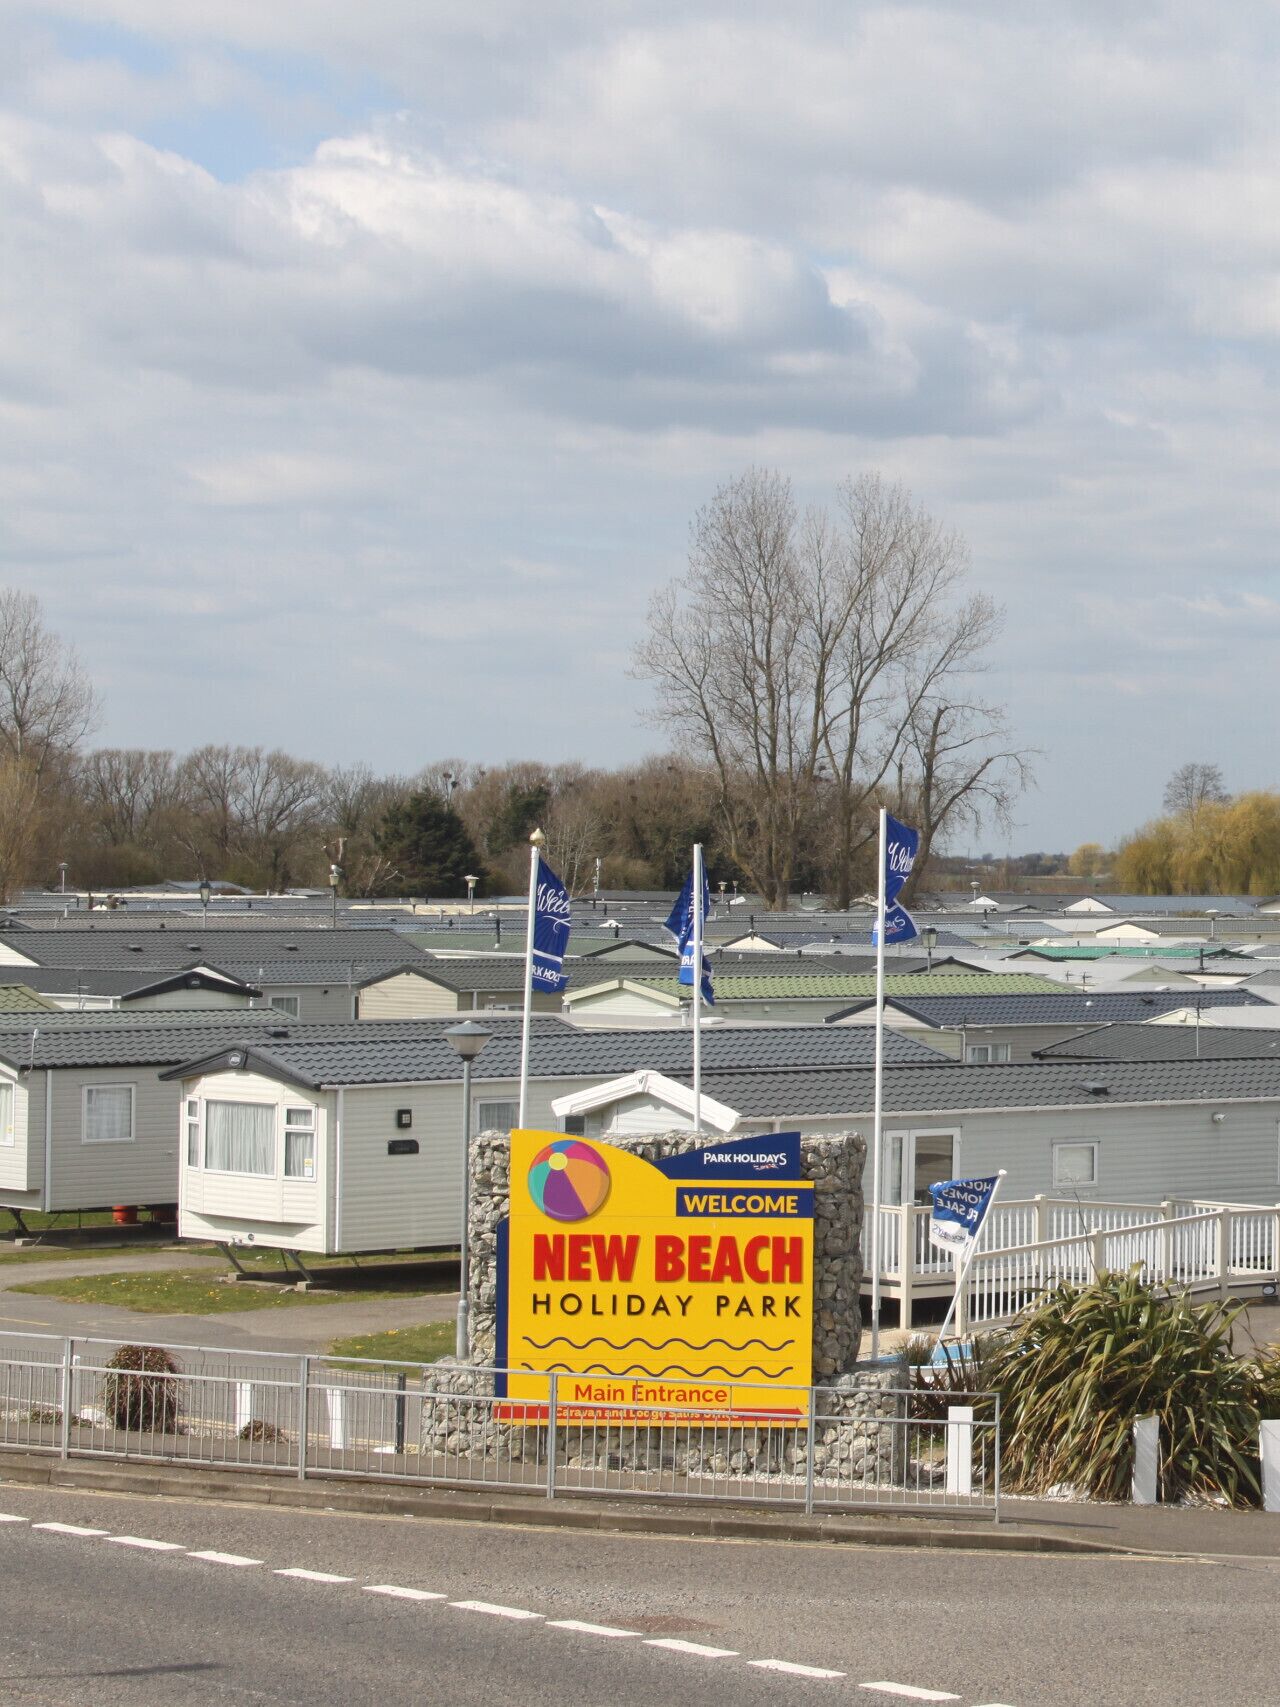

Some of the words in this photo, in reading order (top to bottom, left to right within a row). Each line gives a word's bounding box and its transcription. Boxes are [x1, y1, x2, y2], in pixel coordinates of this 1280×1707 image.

[703, 1152, 732, 1165] PARK
[733, 1152, 787, 1166] HOLIDAYS
[683, 1195, 799, 1214] WELCOME
[534, 1234, 641, 1281] NEW
[655, 1235, 804, 1284] BEACH
[532, 1293, 694, 1317] HOLIDAY
[716, 1295, 801, 1317] PARK
[574, 1384, 625, 1402] Main
[632, 1385, 728, 1403] Entrance
[556, 1407, 602, 1417] Caravan
[604, 1409, 627, 1418] and
